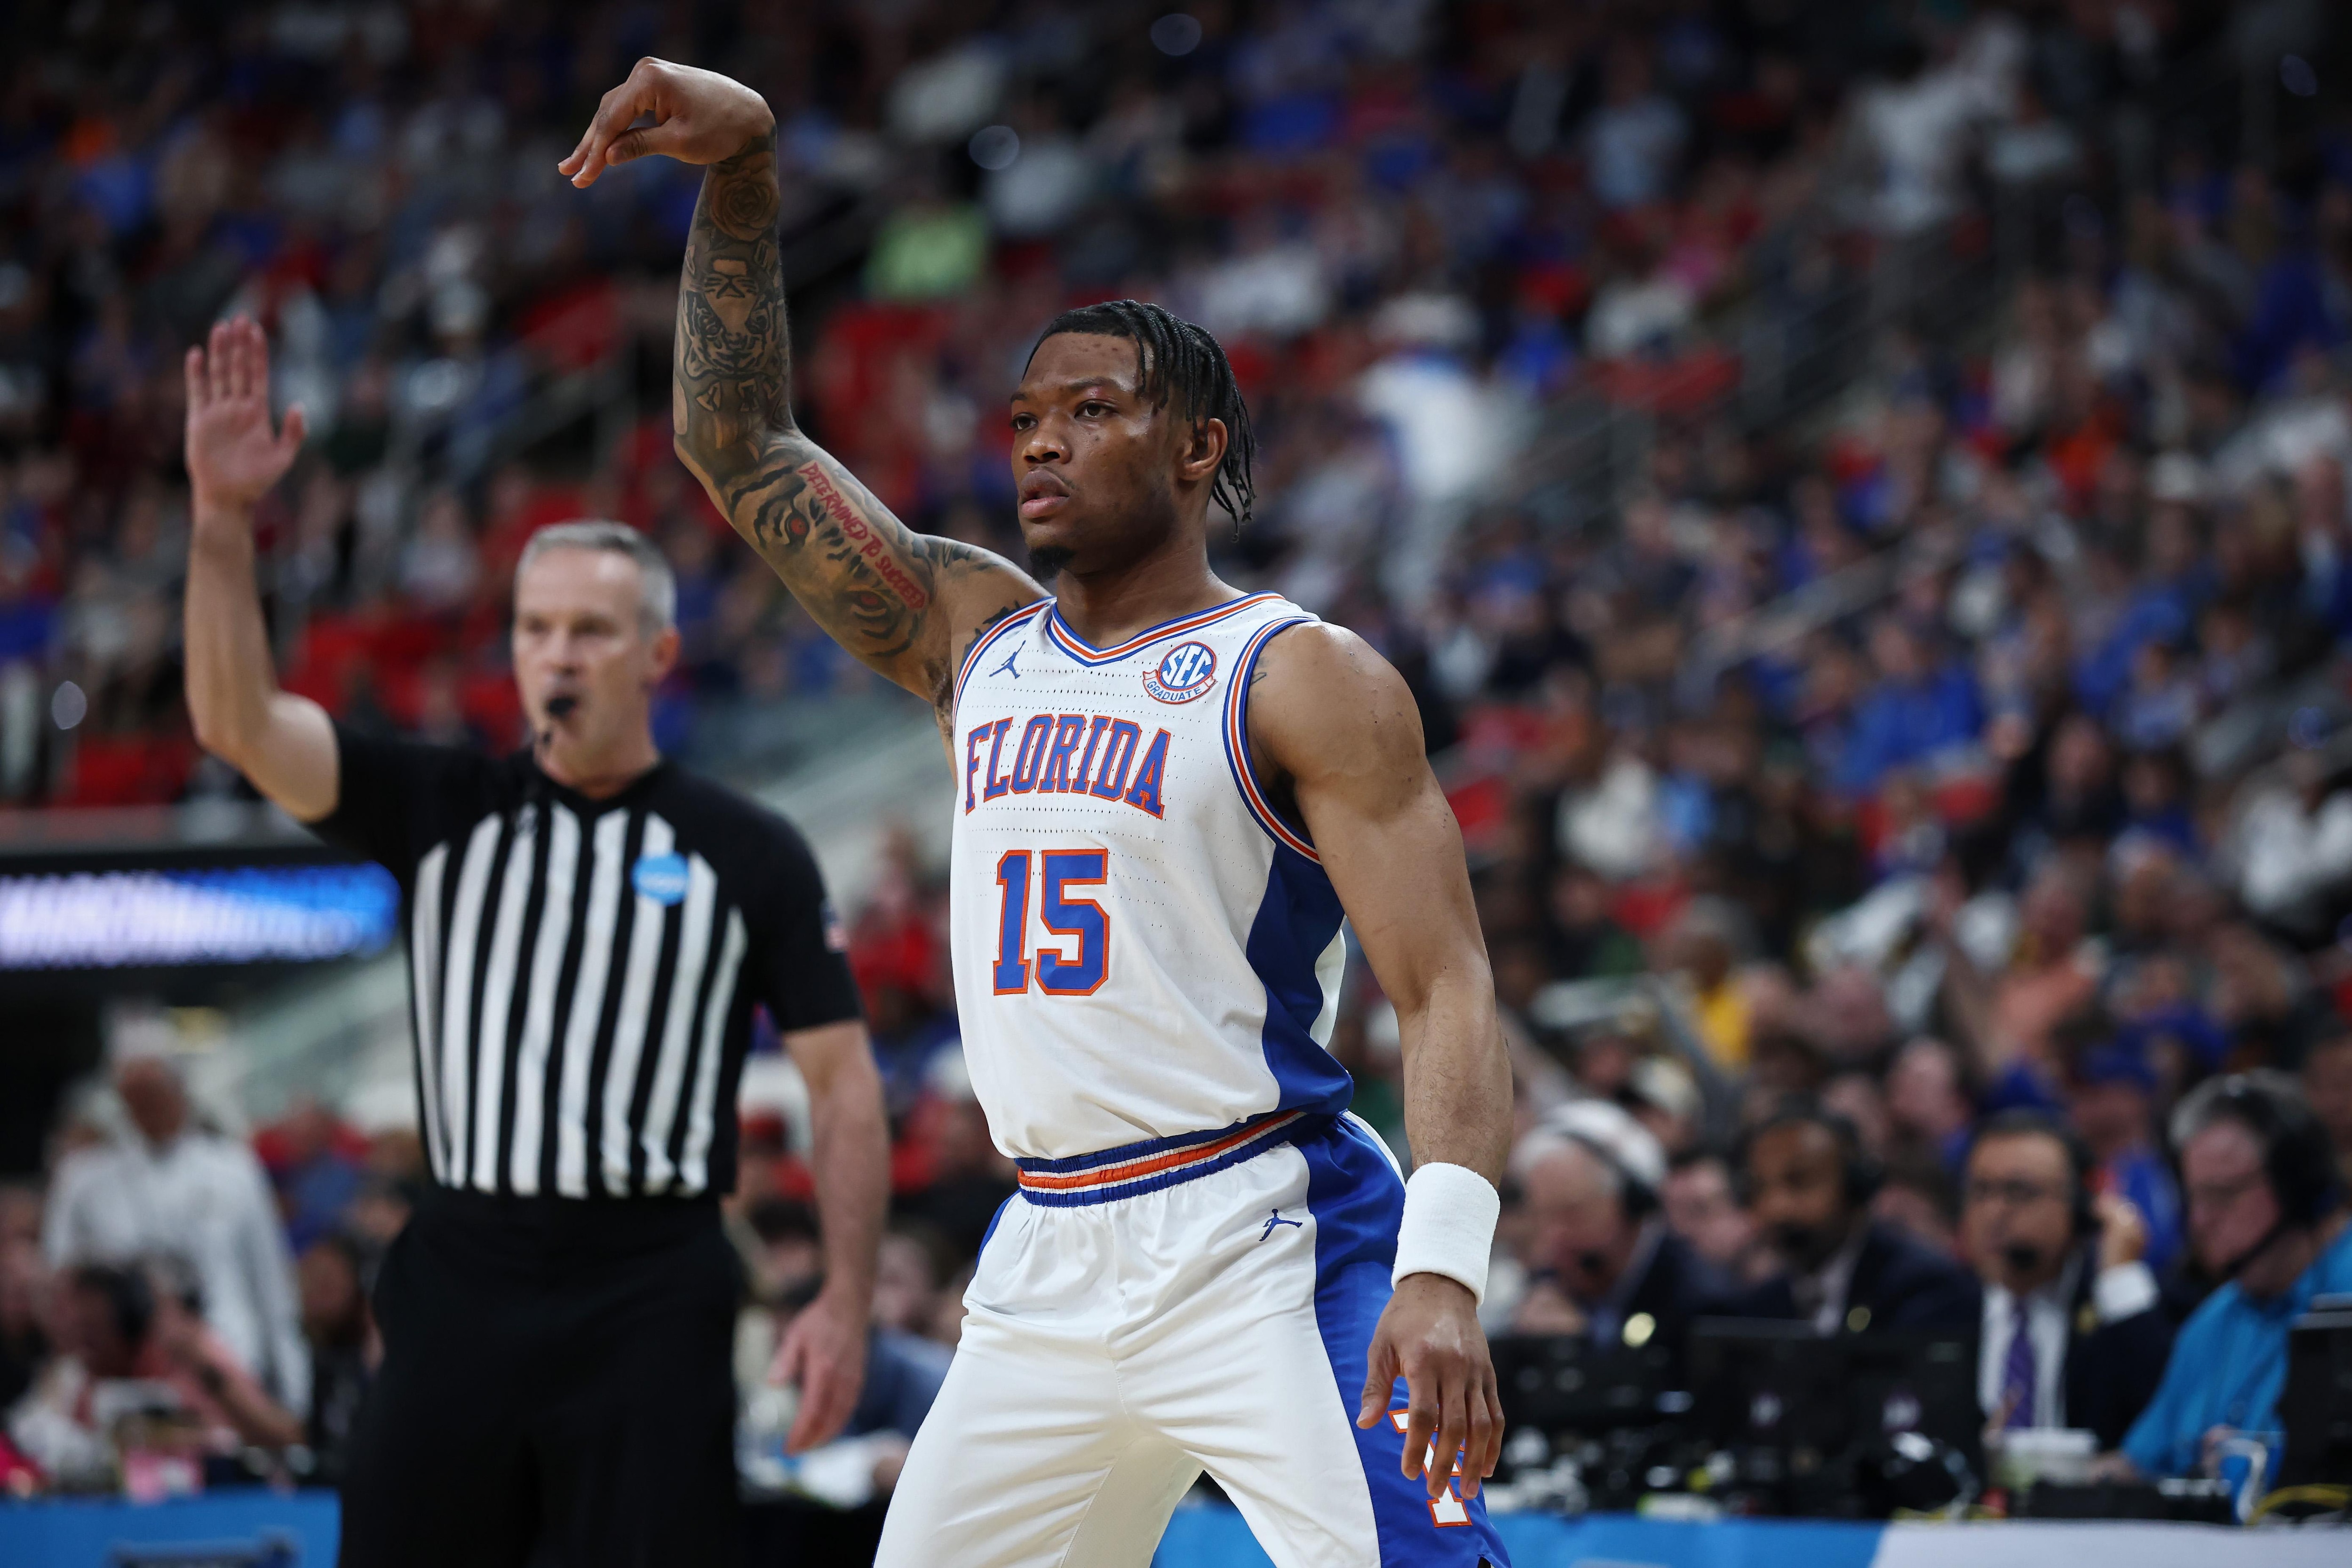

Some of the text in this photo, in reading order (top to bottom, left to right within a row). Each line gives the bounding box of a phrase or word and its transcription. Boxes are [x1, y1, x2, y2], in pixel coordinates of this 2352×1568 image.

[798, 462, 926, 610] DETERMINED TO SUCCEED
[1147, 681, 1202, 701] GRADUATE
[1162, 644, 1212, 687] SEC
[965, 713, 1171, 819] FLORIDA
[993, 848, 1110, 996] 15
